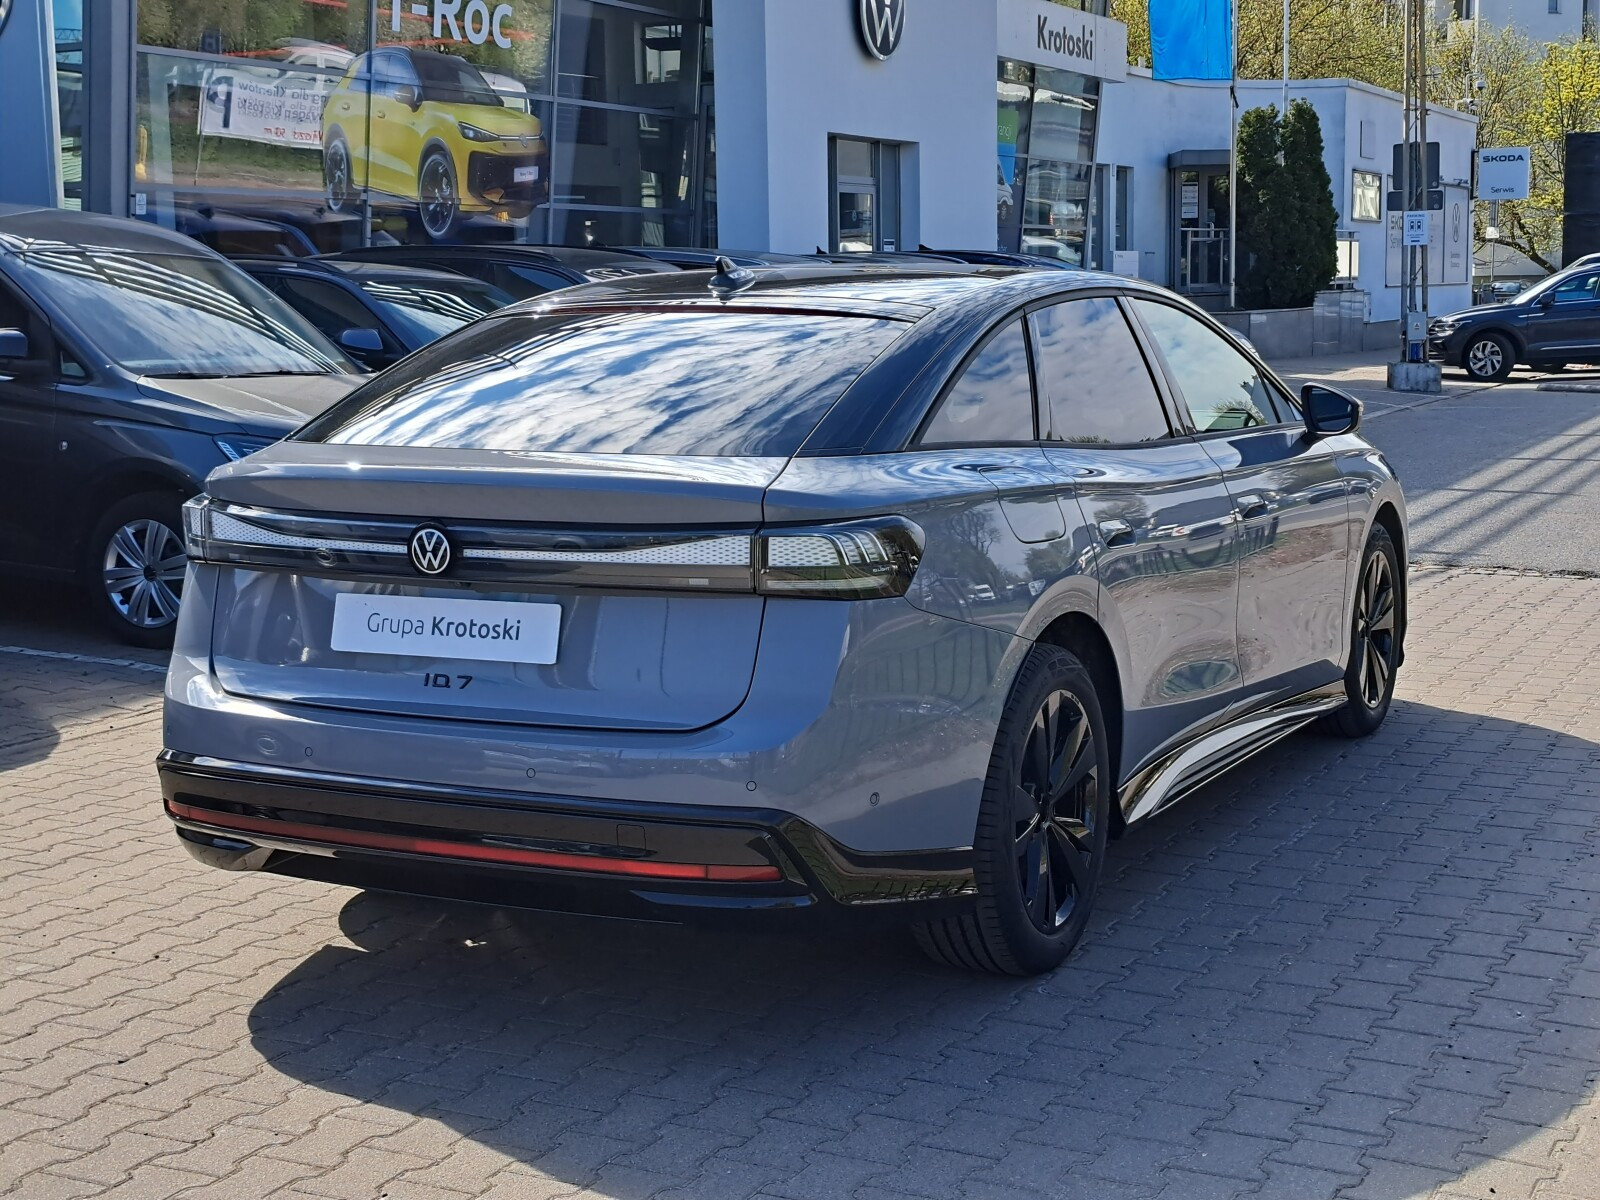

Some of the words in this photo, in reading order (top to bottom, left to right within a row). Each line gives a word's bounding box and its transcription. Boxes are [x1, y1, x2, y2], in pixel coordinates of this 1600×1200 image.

[1037, 14, 1093, 61] Krotoski
[367, 612, 424, 639] Grupa
[431, 616, 521, 641] Krotoski
